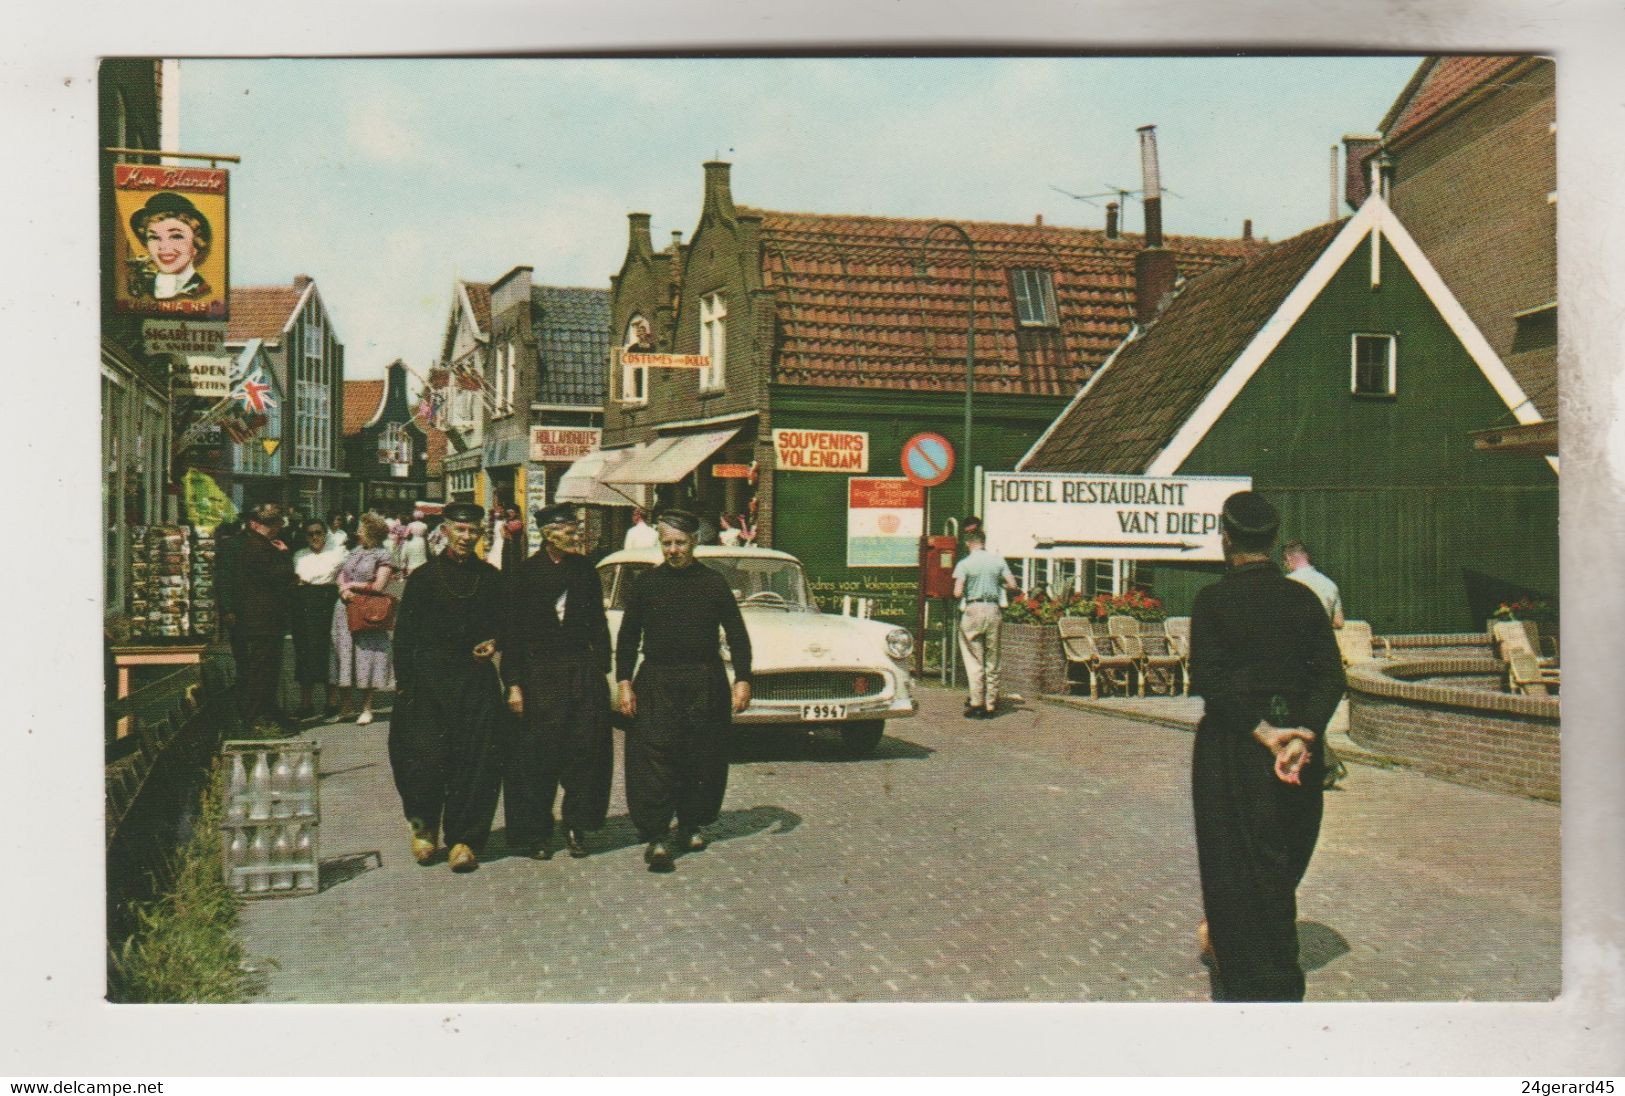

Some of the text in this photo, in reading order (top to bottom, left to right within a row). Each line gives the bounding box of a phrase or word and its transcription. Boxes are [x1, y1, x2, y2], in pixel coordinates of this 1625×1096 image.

[161, 169, 221, 189] Blanche
[778, 432, 864, 450] SOUVENIRS
[780, 450, 863, 469] VOLENDAM
[990, 479, 1188, 506] HOTEL RESTAURANT
[1117, 510, 1159, 534] VAN
[803, 705, 847, 719] F 9947
